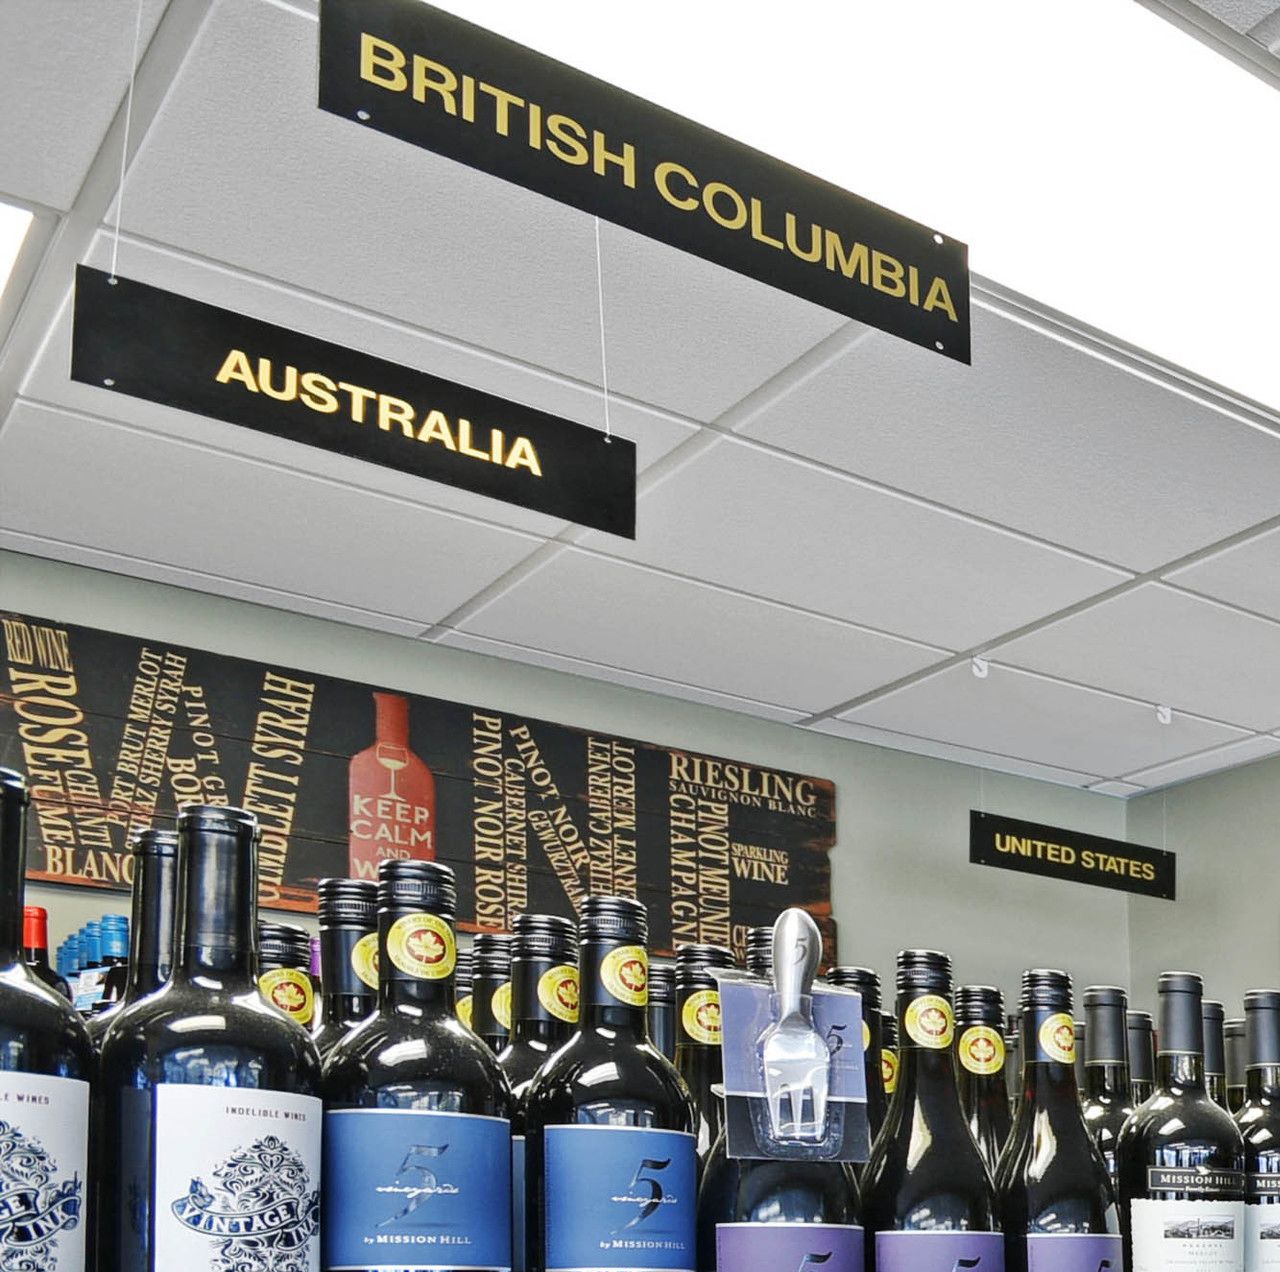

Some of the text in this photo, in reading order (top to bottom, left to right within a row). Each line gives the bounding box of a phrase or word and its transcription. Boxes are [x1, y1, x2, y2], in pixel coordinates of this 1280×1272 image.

[359, 32, 958, 323] BRITISH COLUMBIA
[215, 349, 542, 476] AUSTRALIA
[2, 619, 74, 673] RED WINE
[129, 647, 163, 722] MERLOT
[139, 653, 187, 787] SHERRY SYRAH
[181, 685, 221, 765] PINOT
[252, 672, 315, 766] SYRAH
[117, 724, 145, 775] BRUT
[509, 725, 591, 869] PINOT NOIR
[588, 737, 613, 835] CABERNET
[612, 741, 635, 831] MERLOT
[669, 753, 817, 807] RIESLING
[669, 781, 816, 818] SAUVIGNON BLANC
[351, 819, 432, 849] CALM
[353, 795, 429, 824] KEEP
[473, 713, 505, 930] PINOT NOIR ROSE
[504, 758, 526, 860] CABERNET
[698, 799, 729, 864] PINOT
[376, 847, 410, 860] AND
[731, 843, 790, 864] SPARKLING
[732, 856, 789, 885] WINE
[995, 832, 1155, 881] UNITED STATES
[827, 1024, 847, 1056] 5
[17, 1094, 50, 1105] WINES
[226, 1106, 279, 1119] INDELIBLE
[375, 1144, 449, 1227] 5
[609, 1157, 672, 1235] 5
[1160, 1174, 1237, 1185] MISSION HILL
[27, 1207, 69, 1241] INK
[181, 1206, 291, 1232] VINTAGE
[377, 1235, 472, 1245] MISSION HILL
[612, 1239, 685, 1250] MISSION HILL
